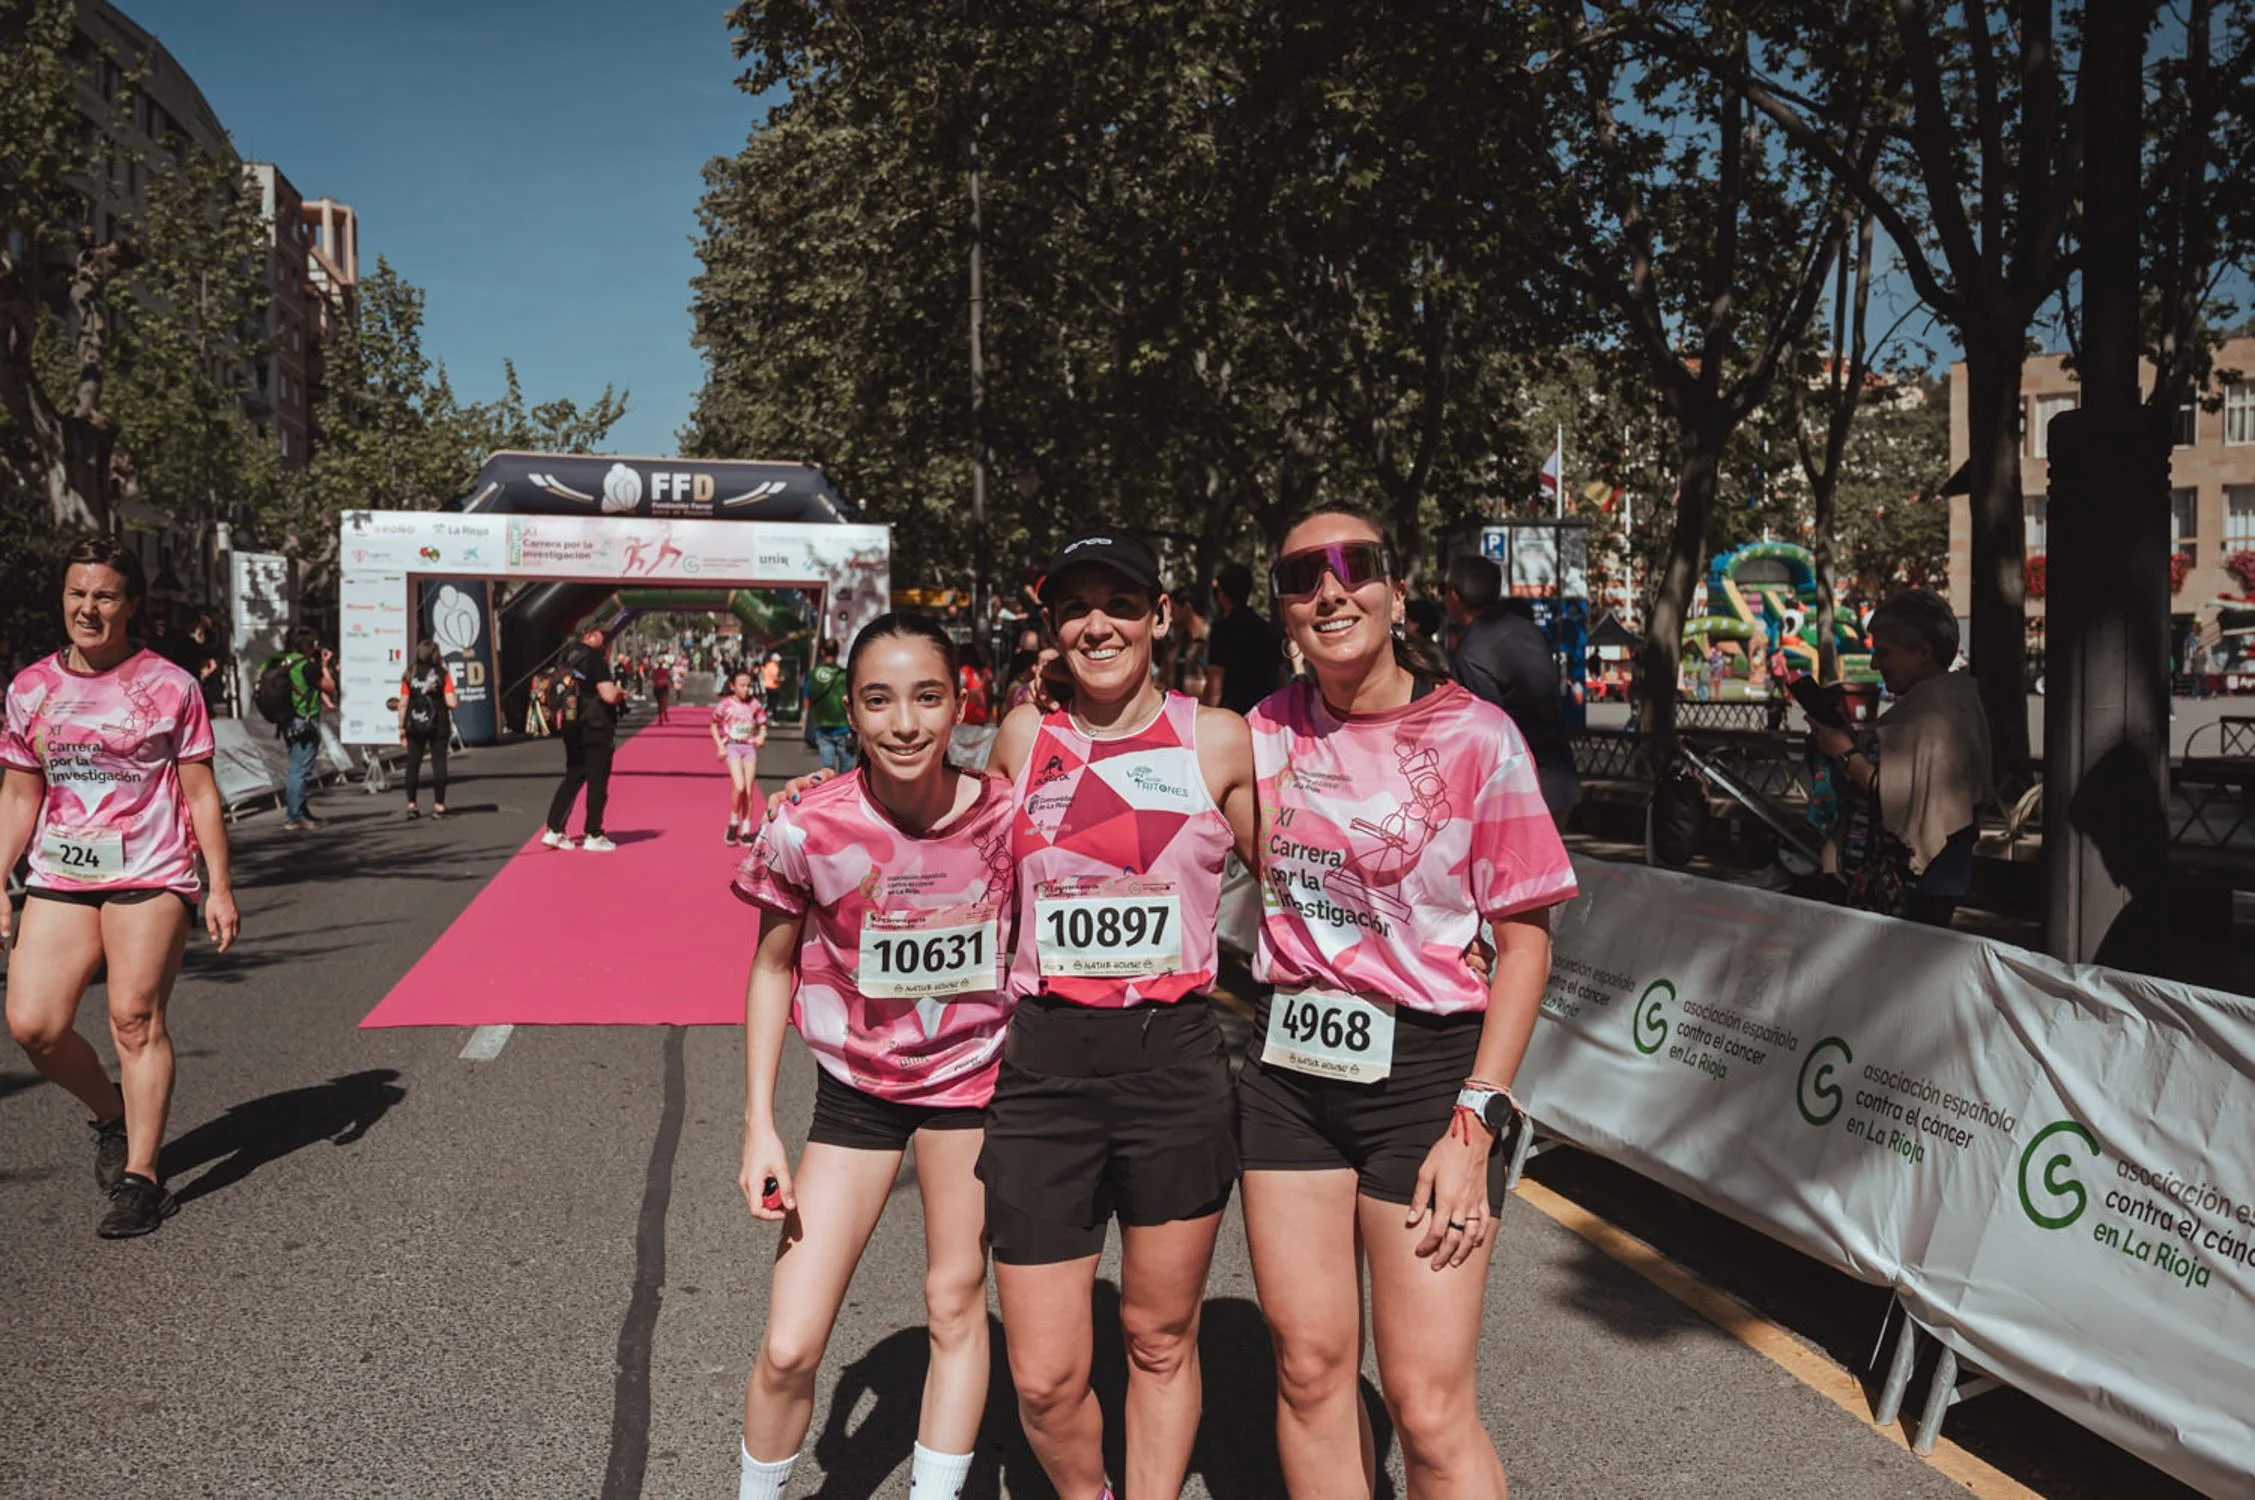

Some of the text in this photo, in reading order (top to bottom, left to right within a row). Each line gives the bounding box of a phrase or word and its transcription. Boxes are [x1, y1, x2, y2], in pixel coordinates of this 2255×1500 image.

[652, 472, 714, 501] FFD
[522, 539, 593, 549] Carrera por la
[1488, 534, 1501, 550] P
[448, 661, 485, 686] FD
[47, 741, 101, 753] Carrera
[49, 756, 90, 770] por la
[1275, 806, 1296, 828] XI
[59, 844, 100, 868] 224
[1270, 834, 1342, 868] Carrera
[1270, 867, 1321, 892] por la
[1047, 906, 1169, 948] 10897
[873, 931, 983, 973] 10631
[1578, 984, 1611, 1006] cáncer
[1592, 968, 1636, 993] española
[1282, 999, 1371, 1052] 4968
[1683, 1000, 1799, 1052] asociación española
[1677, 1021, 1767, 1065] contra el cáncer
[1669, 1045, 1728, 1080] en La Rioja
[1864, 1062, 2017, 1134] asociación española
[1856, 1088, 1975, 1149] contra el cáncer
[1846, 1115, 1926, 1164] en La Rioja
[2116, 1158, 2233, 1218] asociación
[2105, 1190, 2173, 1233] contra
[2177, 1216, 2202, 1242] el
[2093, 1222, 2212, 1288] en La Rioja
